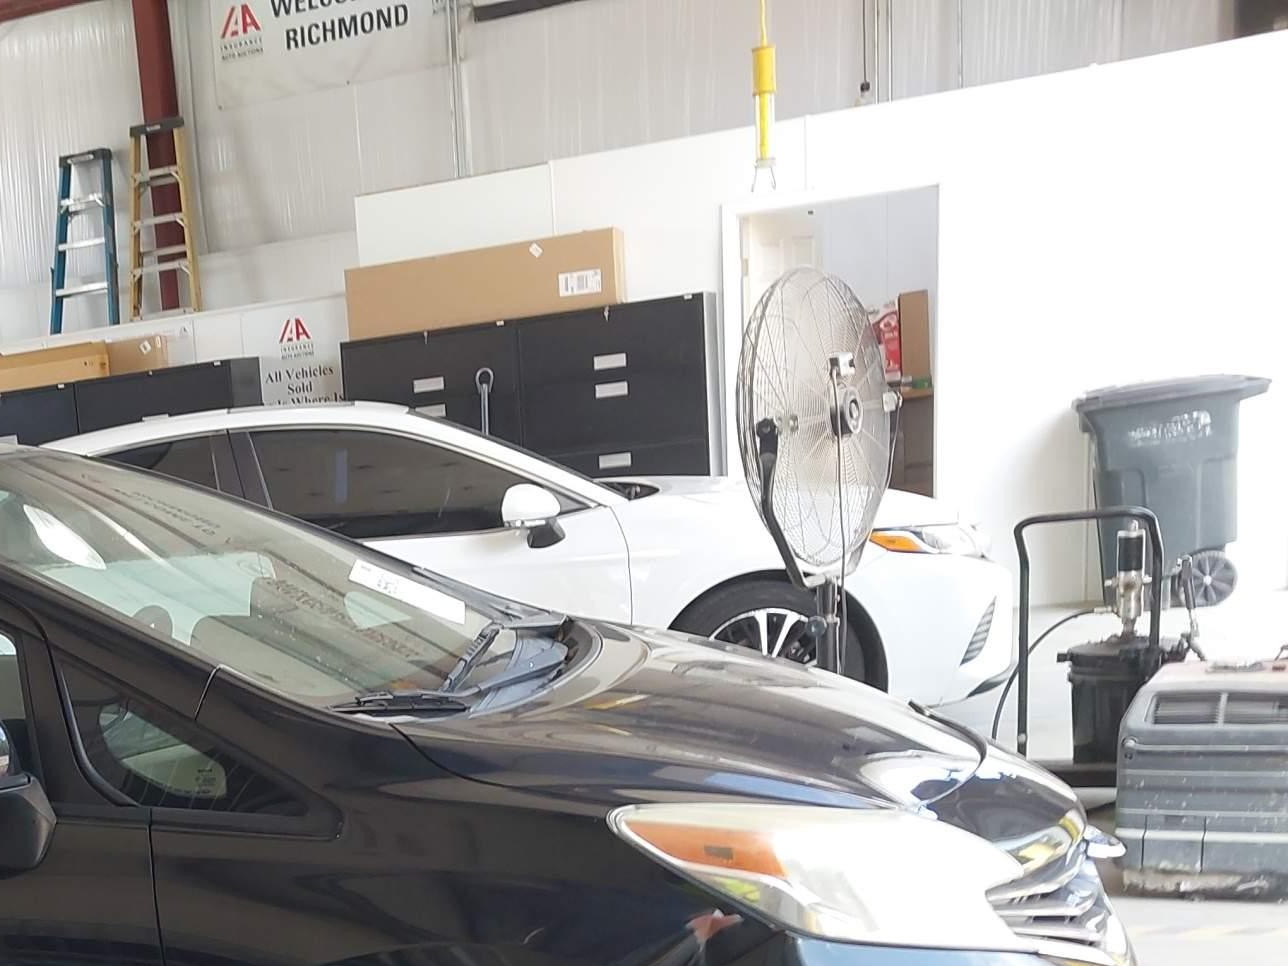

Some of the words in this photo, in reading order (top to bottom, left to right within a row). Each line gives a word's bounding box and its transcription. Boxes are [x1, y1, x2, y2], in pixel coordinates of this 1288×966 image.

[285, 4, 409, 51] RICHMOND
[265, 369, 282, 384] All
[285, 364, 334, 381] Vehicles
[287, 380, 313, 396] Sold
